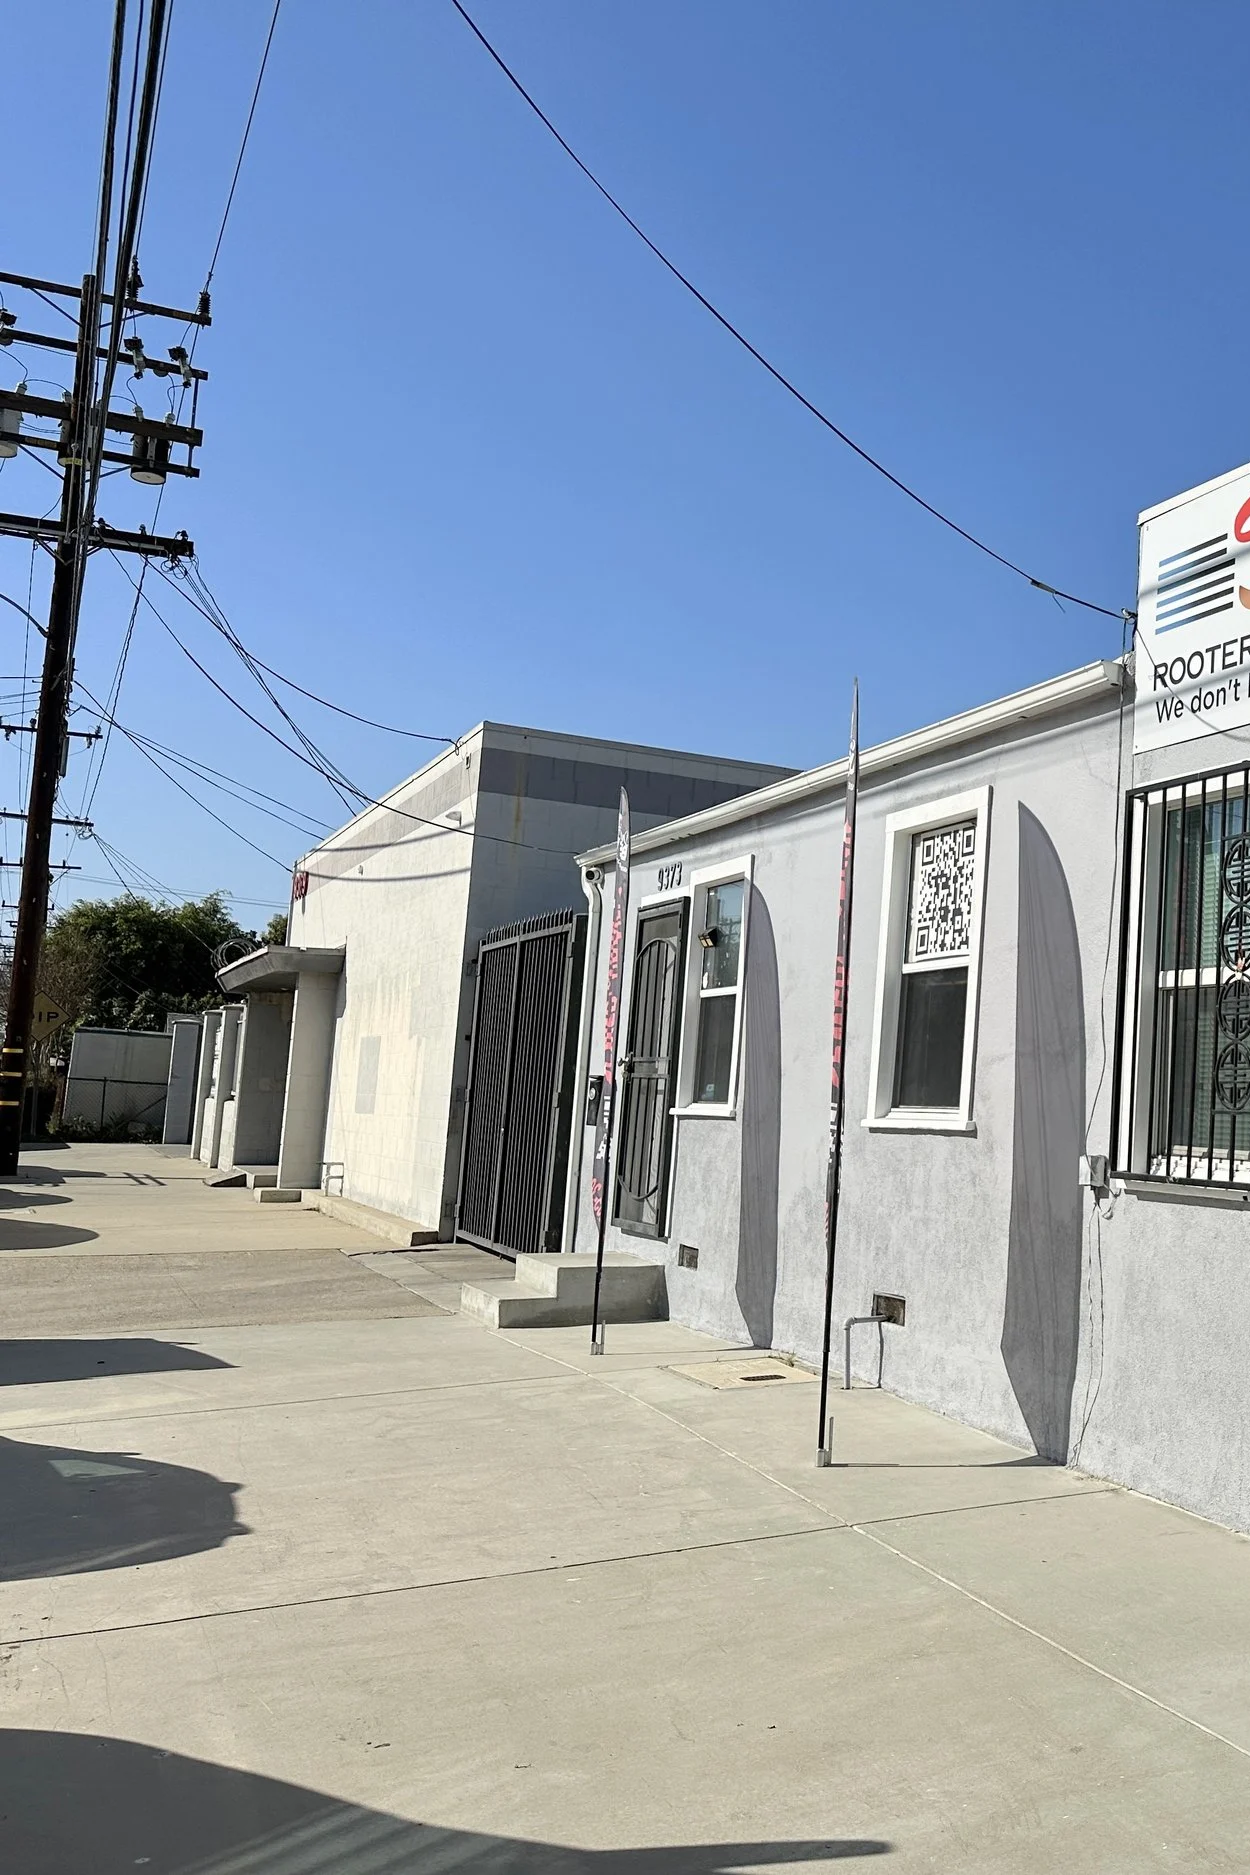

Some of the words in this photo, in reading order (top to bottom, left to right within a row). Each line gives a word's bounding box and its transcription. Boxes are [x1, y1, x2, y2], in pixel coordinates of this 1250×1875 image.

[1155, 696, 1184, 724] We
[1190, 679, 1241, 714] don't
[657, 860, 683, 892] 9373
[35, 1011, 60, 1023] IP
